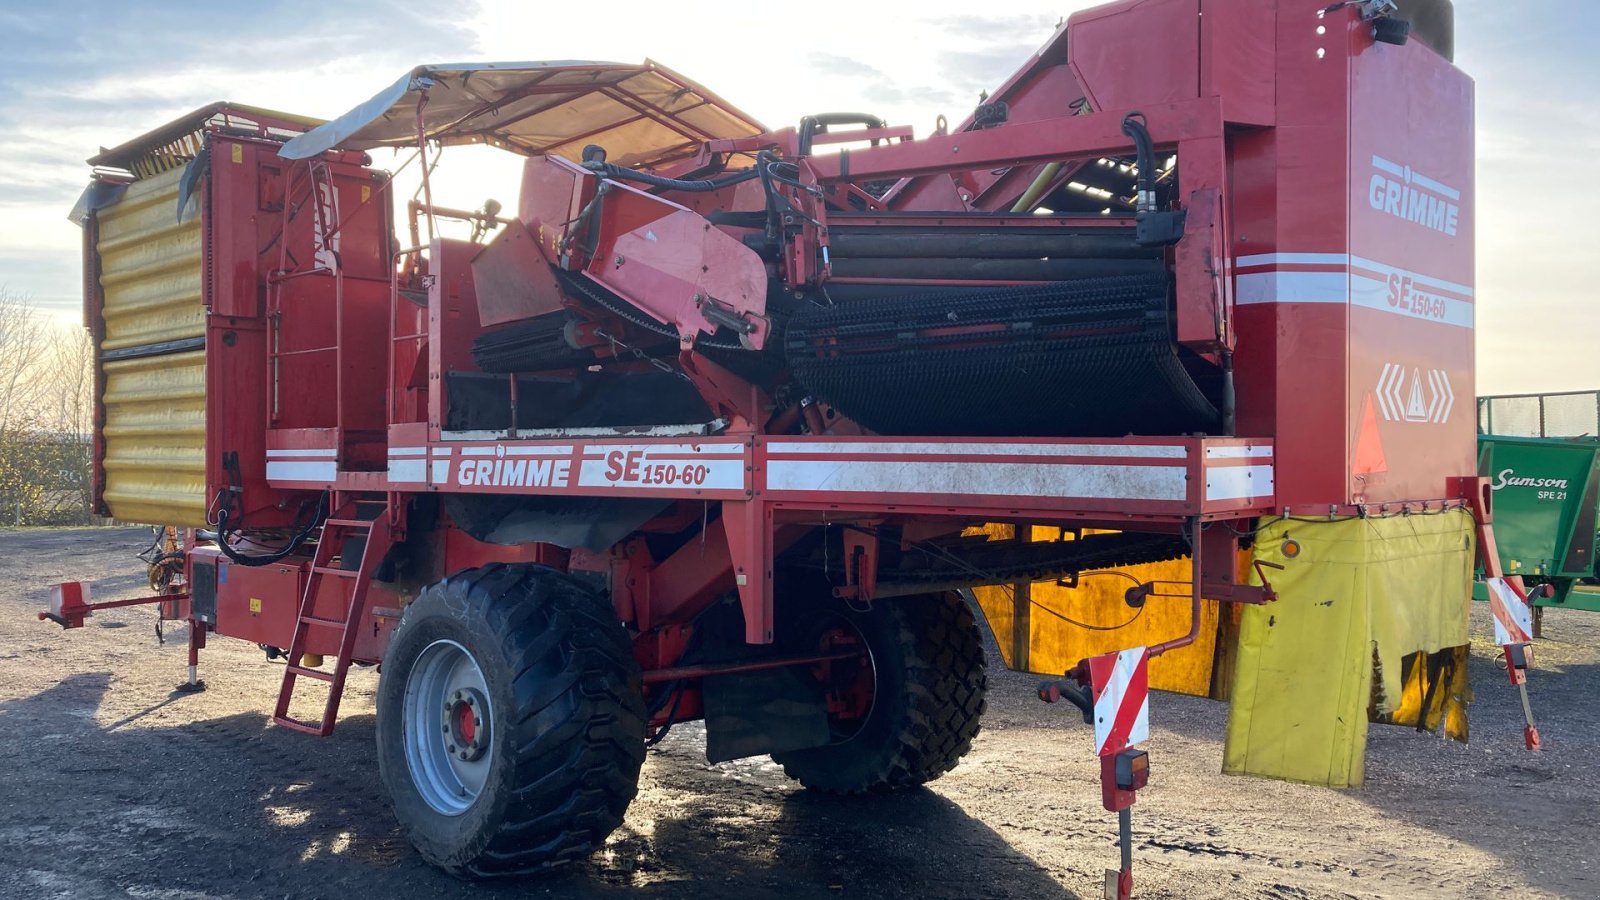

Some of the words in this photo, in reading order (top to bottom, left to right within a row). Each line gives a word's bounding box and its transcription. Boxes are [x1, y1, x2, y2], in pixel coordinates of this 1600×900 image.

[1369, 165, 1459, 236] GRIMME
[1387, 273, 1411, 310] SE
[1410, 293, 1446, 319] 150-60
[458, 443, 571, 487] GRIMME
[605, 450, 643, 481] SE
[642, 464, 706, 485] 150-60
[1491, 468, 1568, 490] Samson
[1537, 491, 1555, 500] SPE
[1556, 491, 1567, 500] 21
